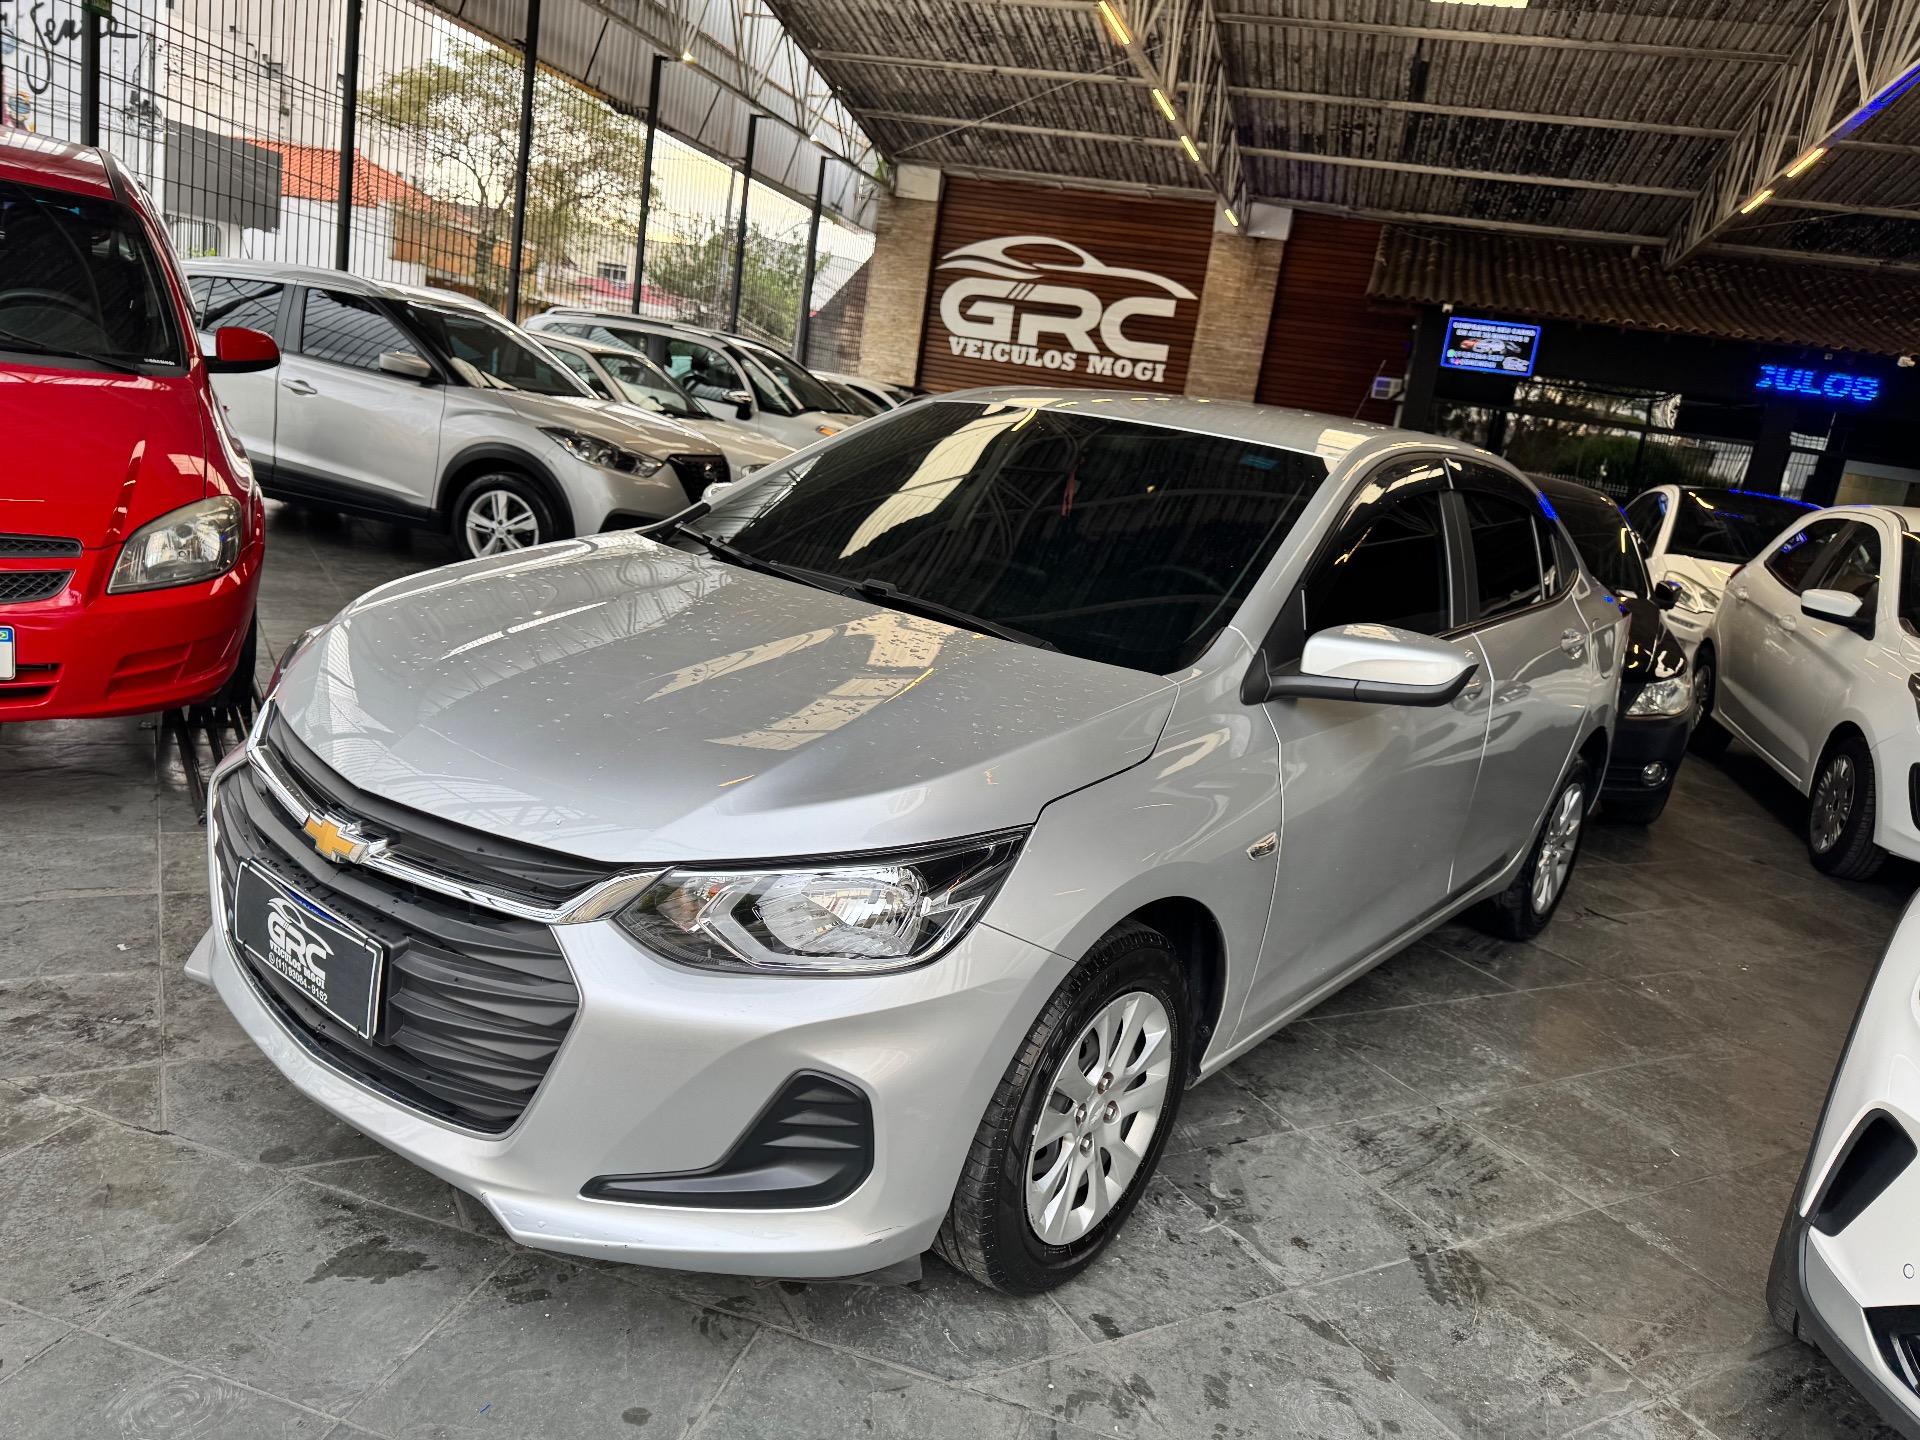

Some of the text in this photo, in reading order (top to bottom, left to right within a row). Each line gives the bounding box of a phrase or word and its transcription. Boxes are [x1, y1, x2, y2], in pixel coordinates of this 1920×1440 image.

[939, 277, 1178, 363] GRC
[948, 335, 1167, 383] VEICULOS MOGI
[267, 911, 327, 978] GRC
[269, 939, 325, 989] VEICULOS MOGI
[275, 956, 288, 976] (11)
